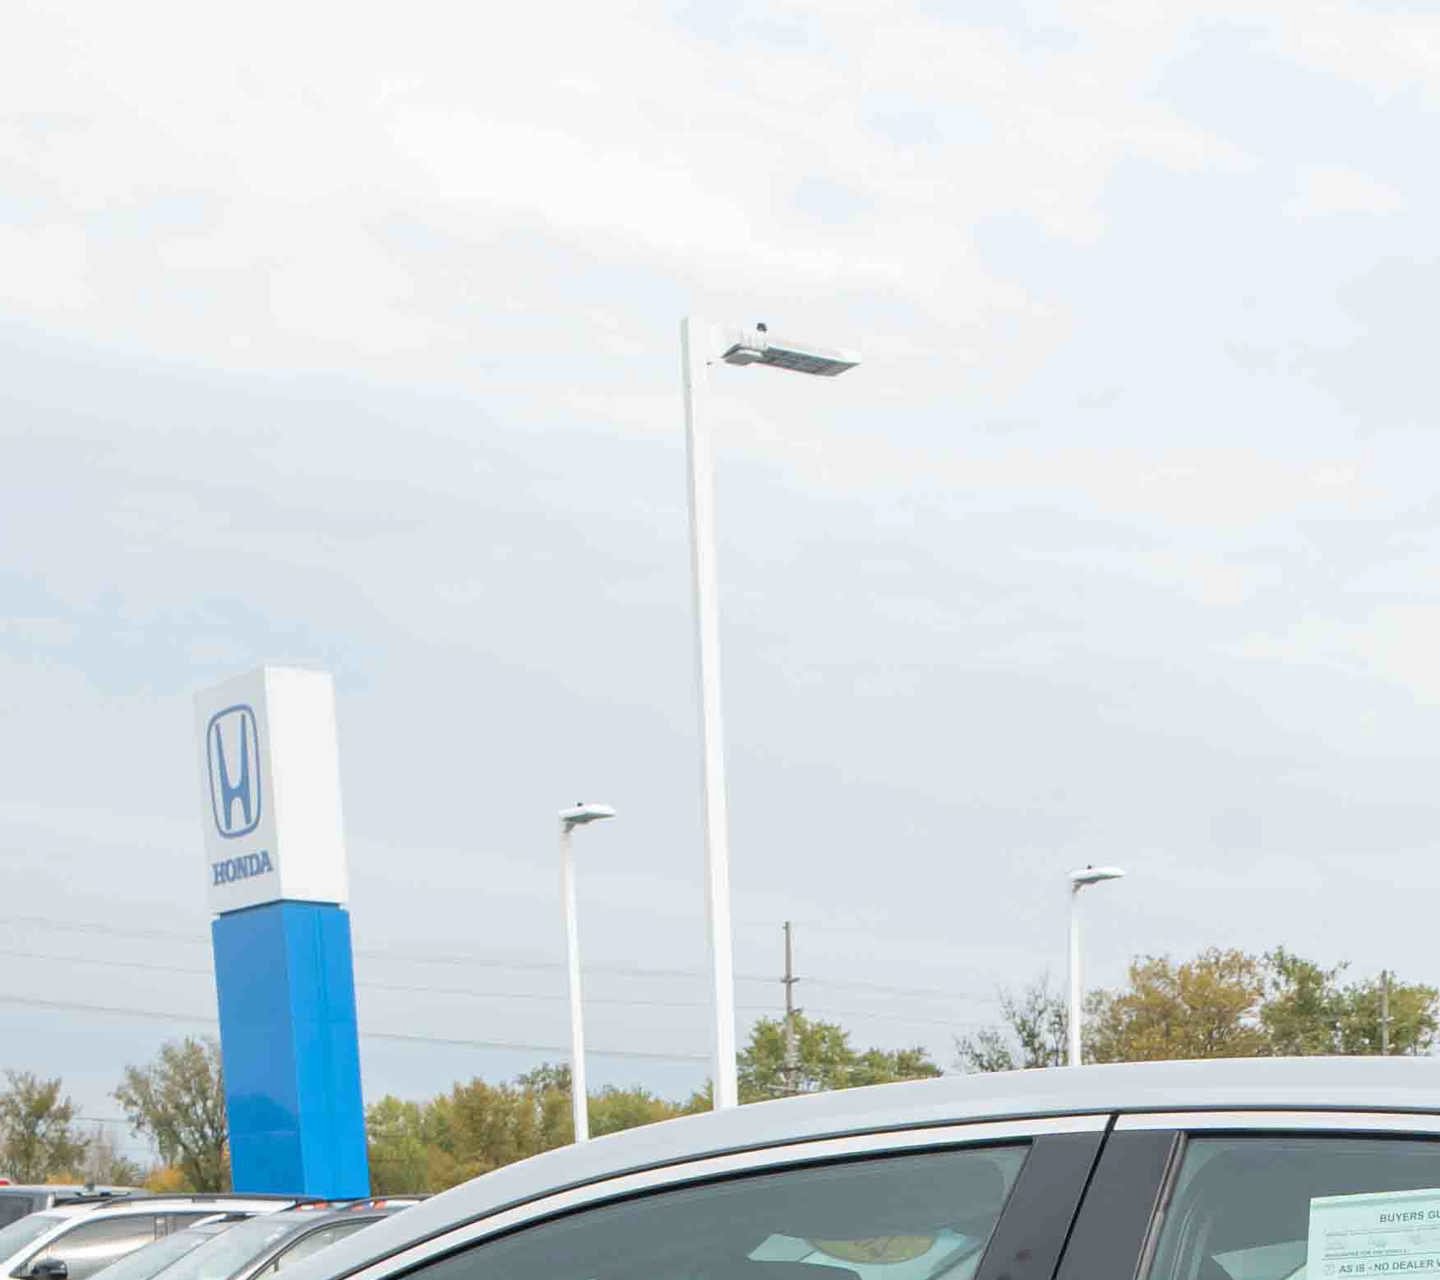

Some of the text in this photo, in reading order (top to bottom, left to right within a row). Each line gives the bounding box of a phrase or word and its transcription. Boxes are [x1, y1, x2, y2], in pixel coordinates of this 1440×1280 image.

[212, 850, 274, 887] HONDA
[1379, 1211, 1425, 1224] BUYERS
[1339, 1263, 1353, 1274] AS
[1356, 1263, 1366, 1273] IS
[1374, 1261, 1390, 1272] NO
[1392, 1257, 1435, 1271] DEALER
